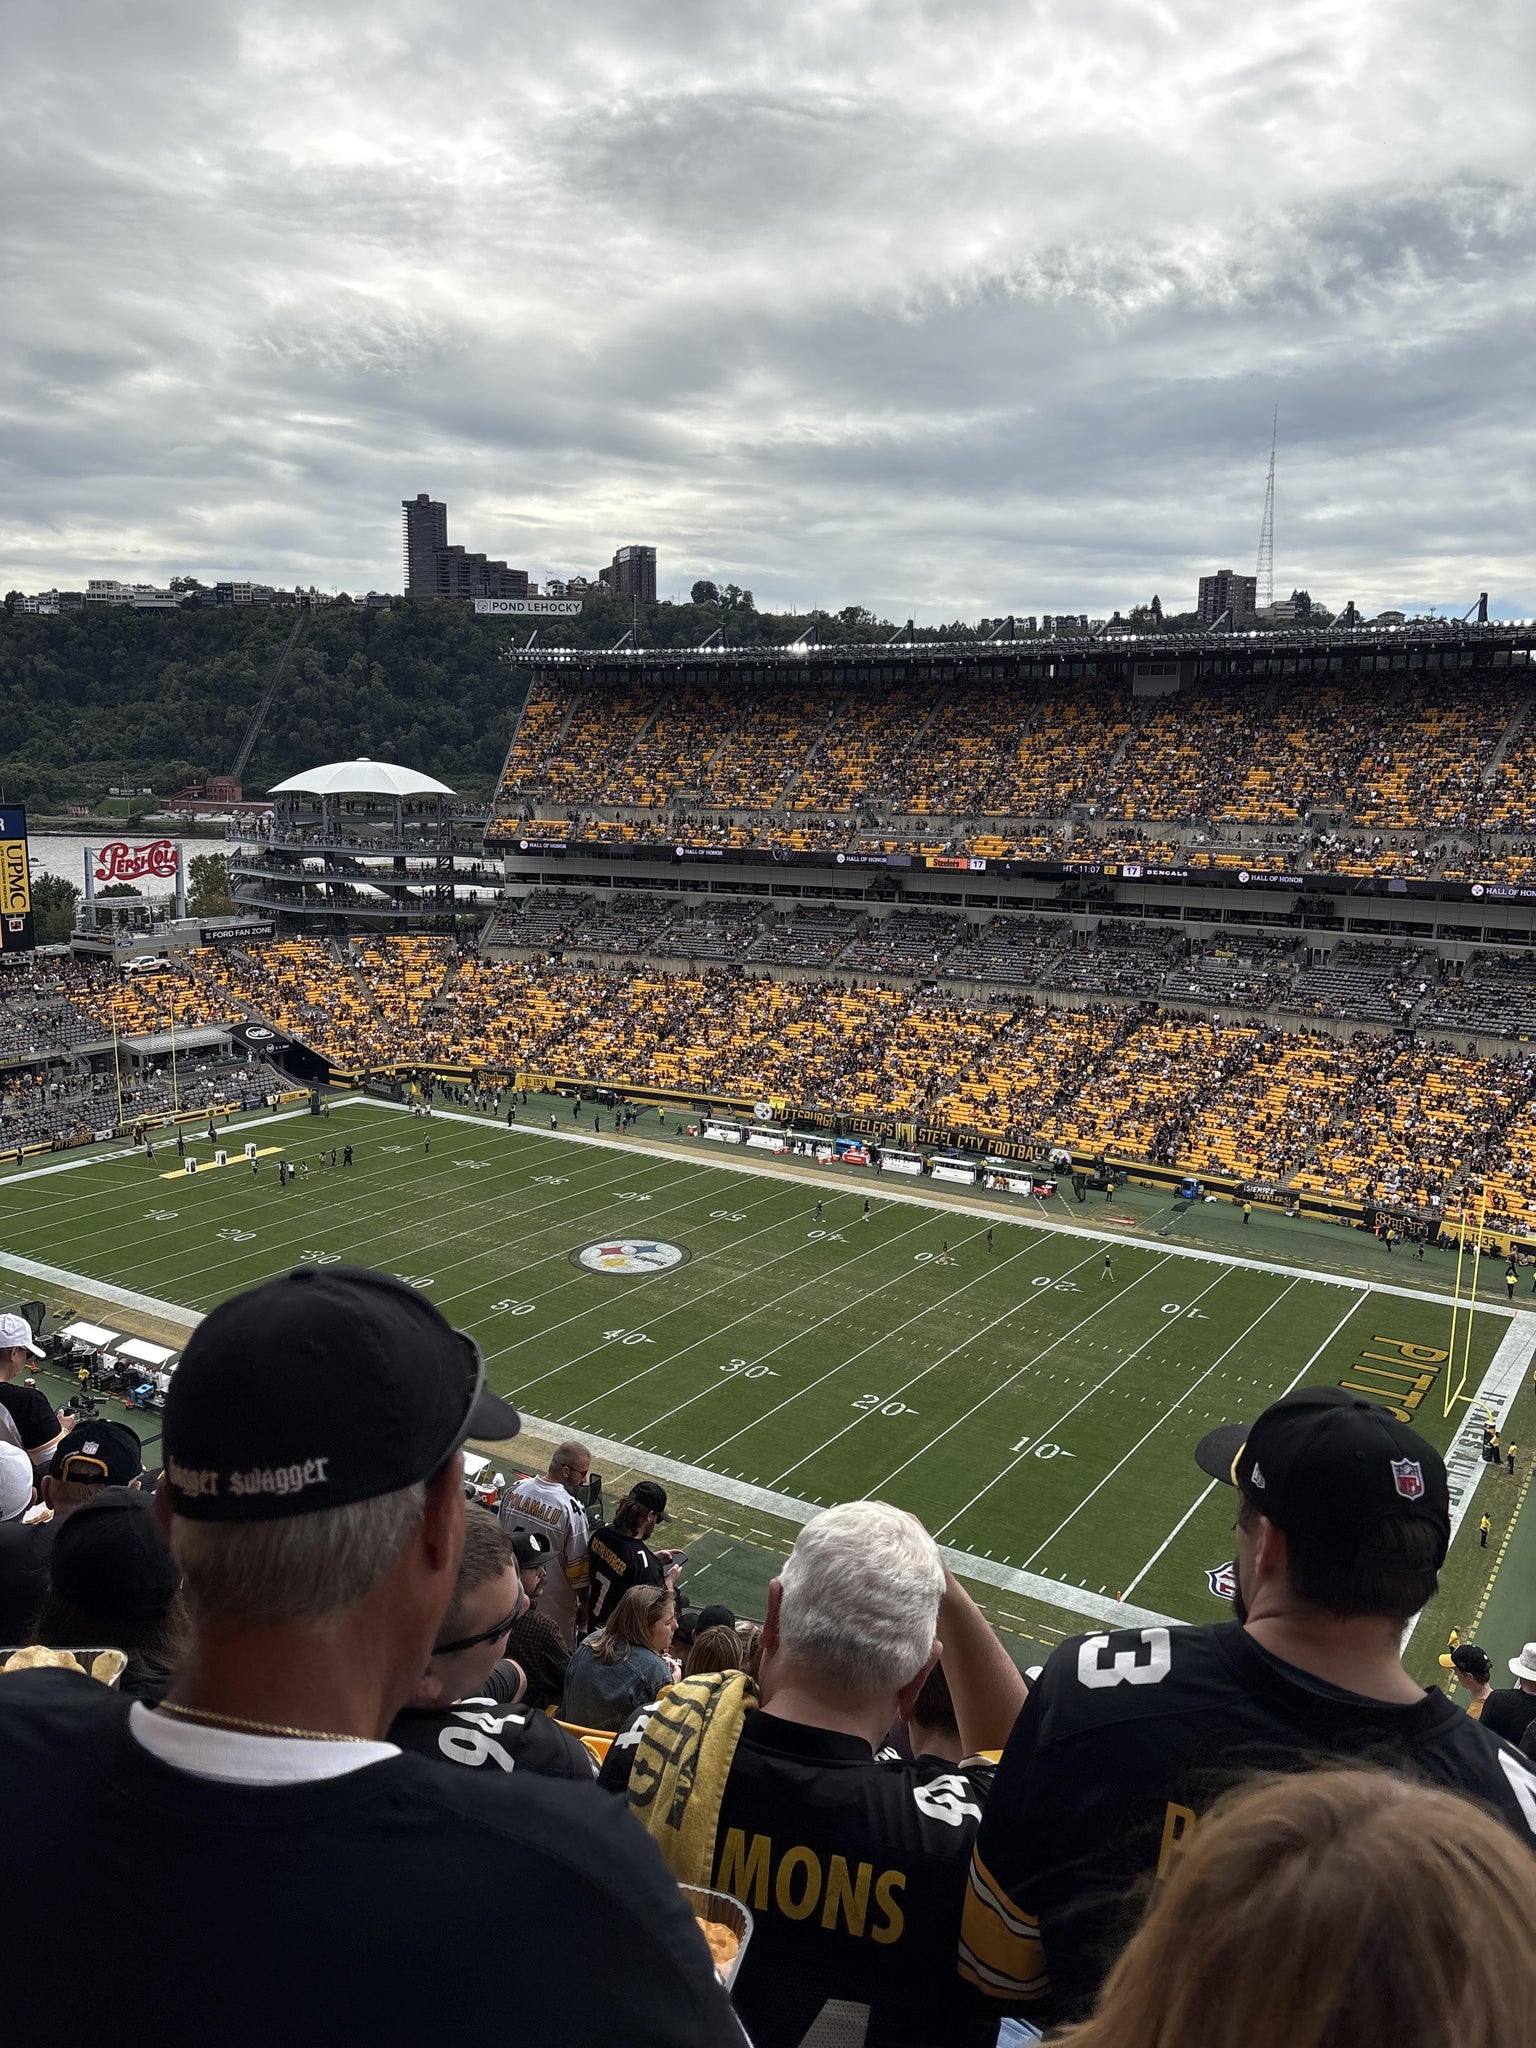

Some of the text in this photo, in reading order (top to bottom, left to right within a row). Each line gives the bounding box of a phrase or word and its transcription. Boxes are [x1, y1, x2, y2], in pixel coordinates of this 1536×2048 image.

[492, 602, 580, 612] POND LEHOCKY
[529, 841, 543, 849] HALL
[933, 858, 983, 869] Steelers 17
[1126, 867, 1138, 875] 17
[1146, 869, 1188, 877] BENGALS
[6, 844, 26, 909] UPMC
[212, 930, 234, 939] FORD
[235, 928, 251, 936] FAN
[251, 926, 272, 935] ZONE
[849, 1116, 894, 1137] TEELERS
[709, 1210, 747, 1222] 50
[215, 1228, 257, 1242] 20
[300, 1250, 342, 1265] 30
[490, 1298, 536, 1316] 50
[602, 1328, 647, 1345] 40
[719, 1358, 769, 1379] 30
[850, 1394, 907, 1416] 20
[1009, 1436, 1061, 1460] 10
[507, 1492, 563, 1525] POLAMALU
[1077, 1627, 1172, 1690] 3
